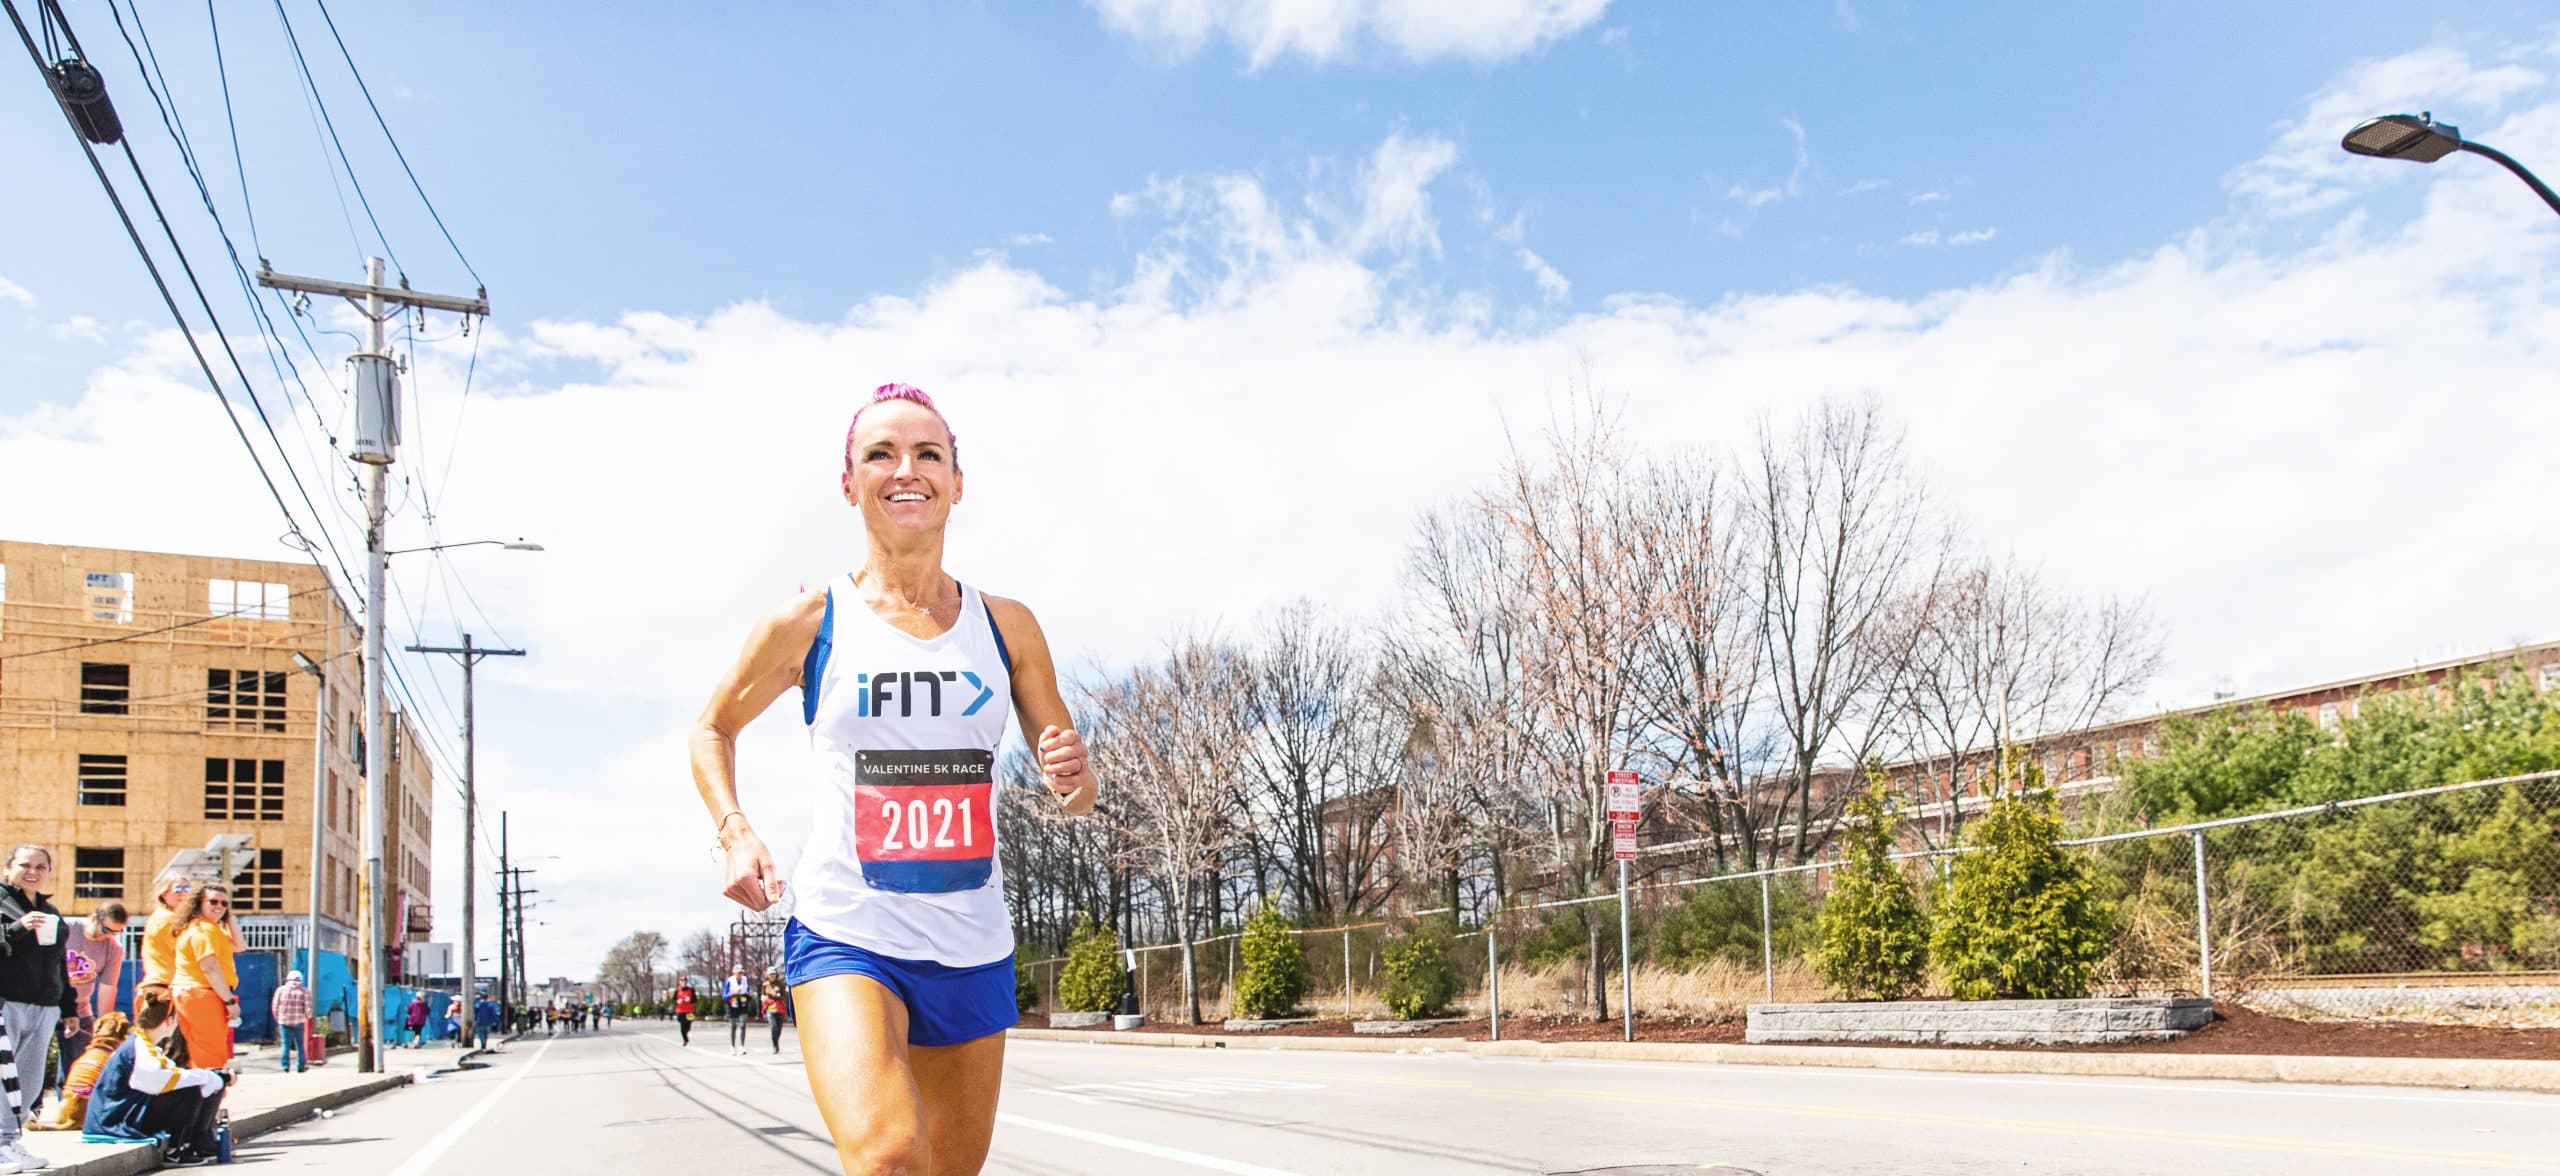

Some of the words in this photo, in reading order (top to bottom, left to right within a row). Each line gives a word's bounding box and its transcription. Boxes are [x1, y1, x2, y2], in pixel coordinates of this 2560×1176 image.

[863, 764, 930, 774] VALENTINE
[934, 764, 950, 774] 5K
[952, 763, 985, 774] RACE
[881, 797, 973, 851] 2021
